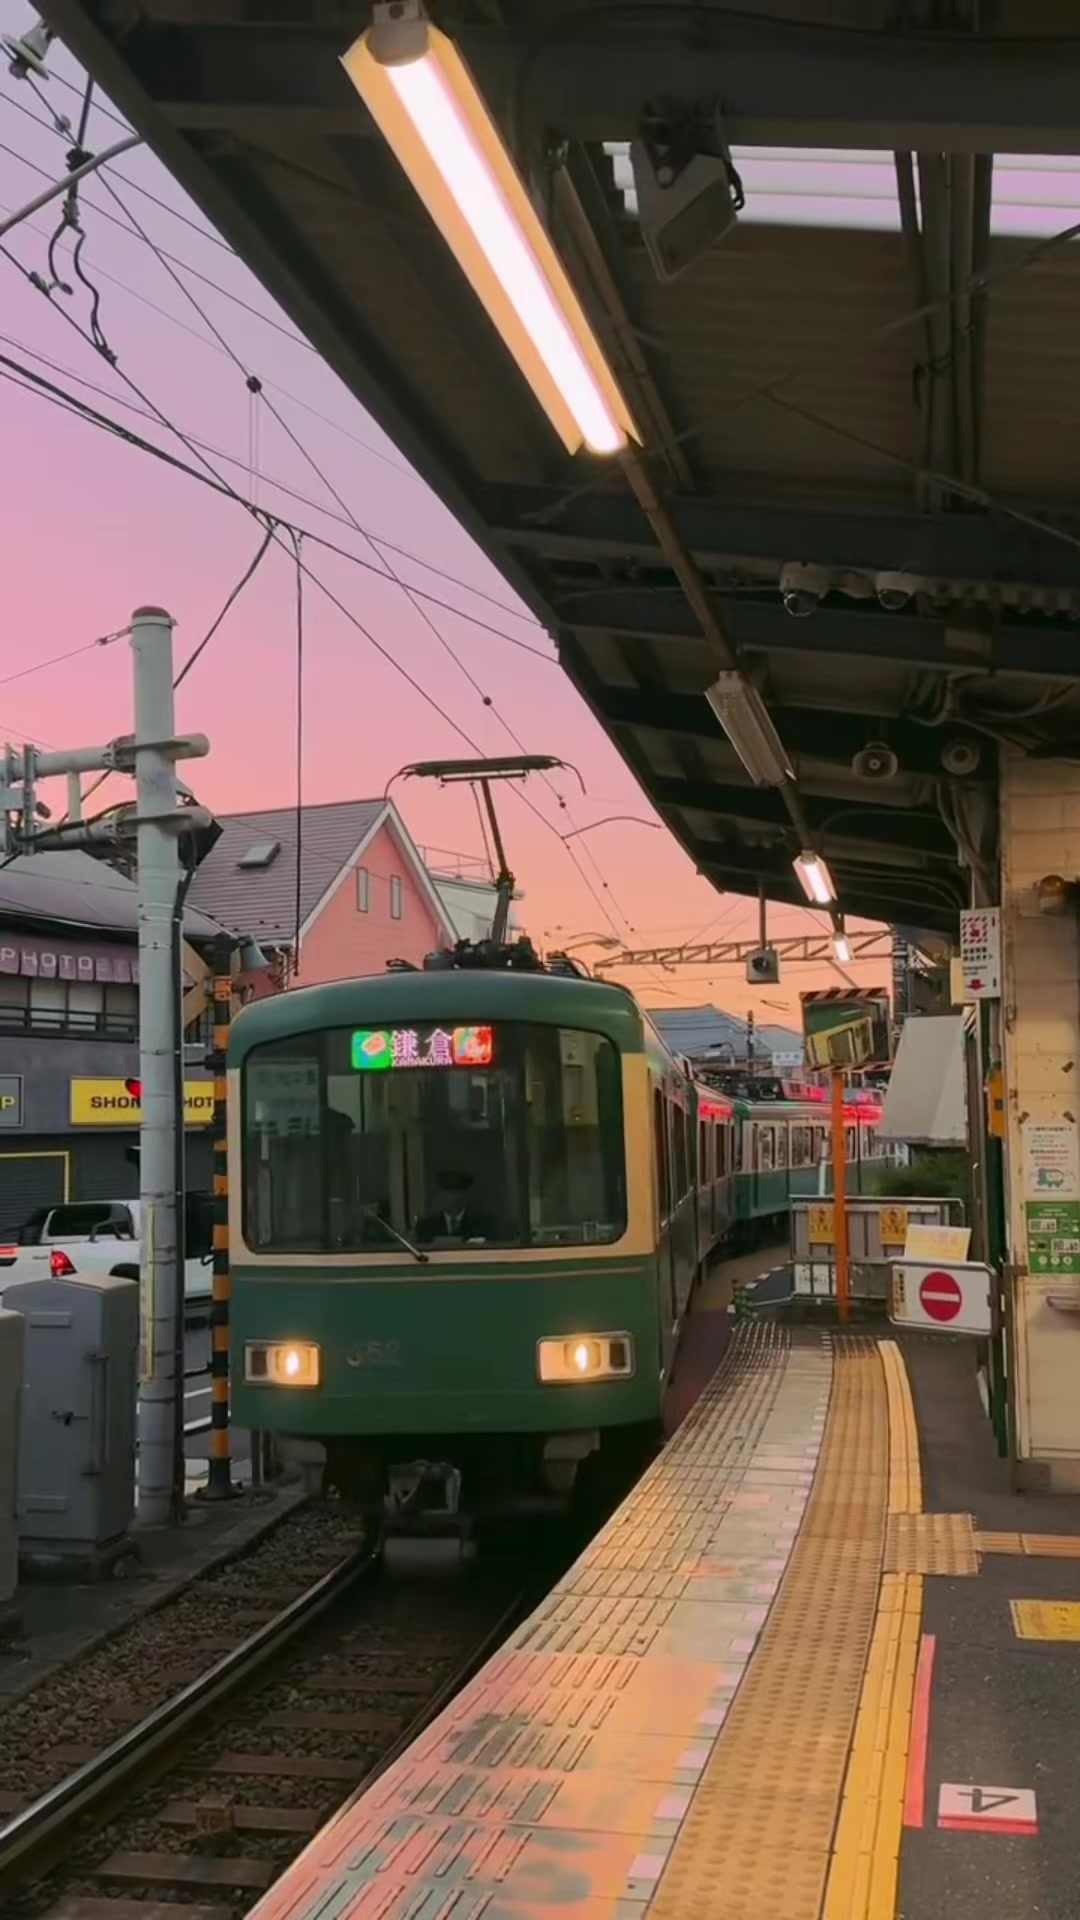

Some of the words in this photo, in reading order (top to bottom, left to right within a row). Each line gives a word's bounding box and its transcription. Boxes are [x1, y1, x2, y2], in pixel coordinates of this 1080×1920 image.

[391, 1029, 452, 1057] 鎌倉
[391, 1056, 453, 1067] KAMAKURA
[956, 1788, 1019, 1813] 4
